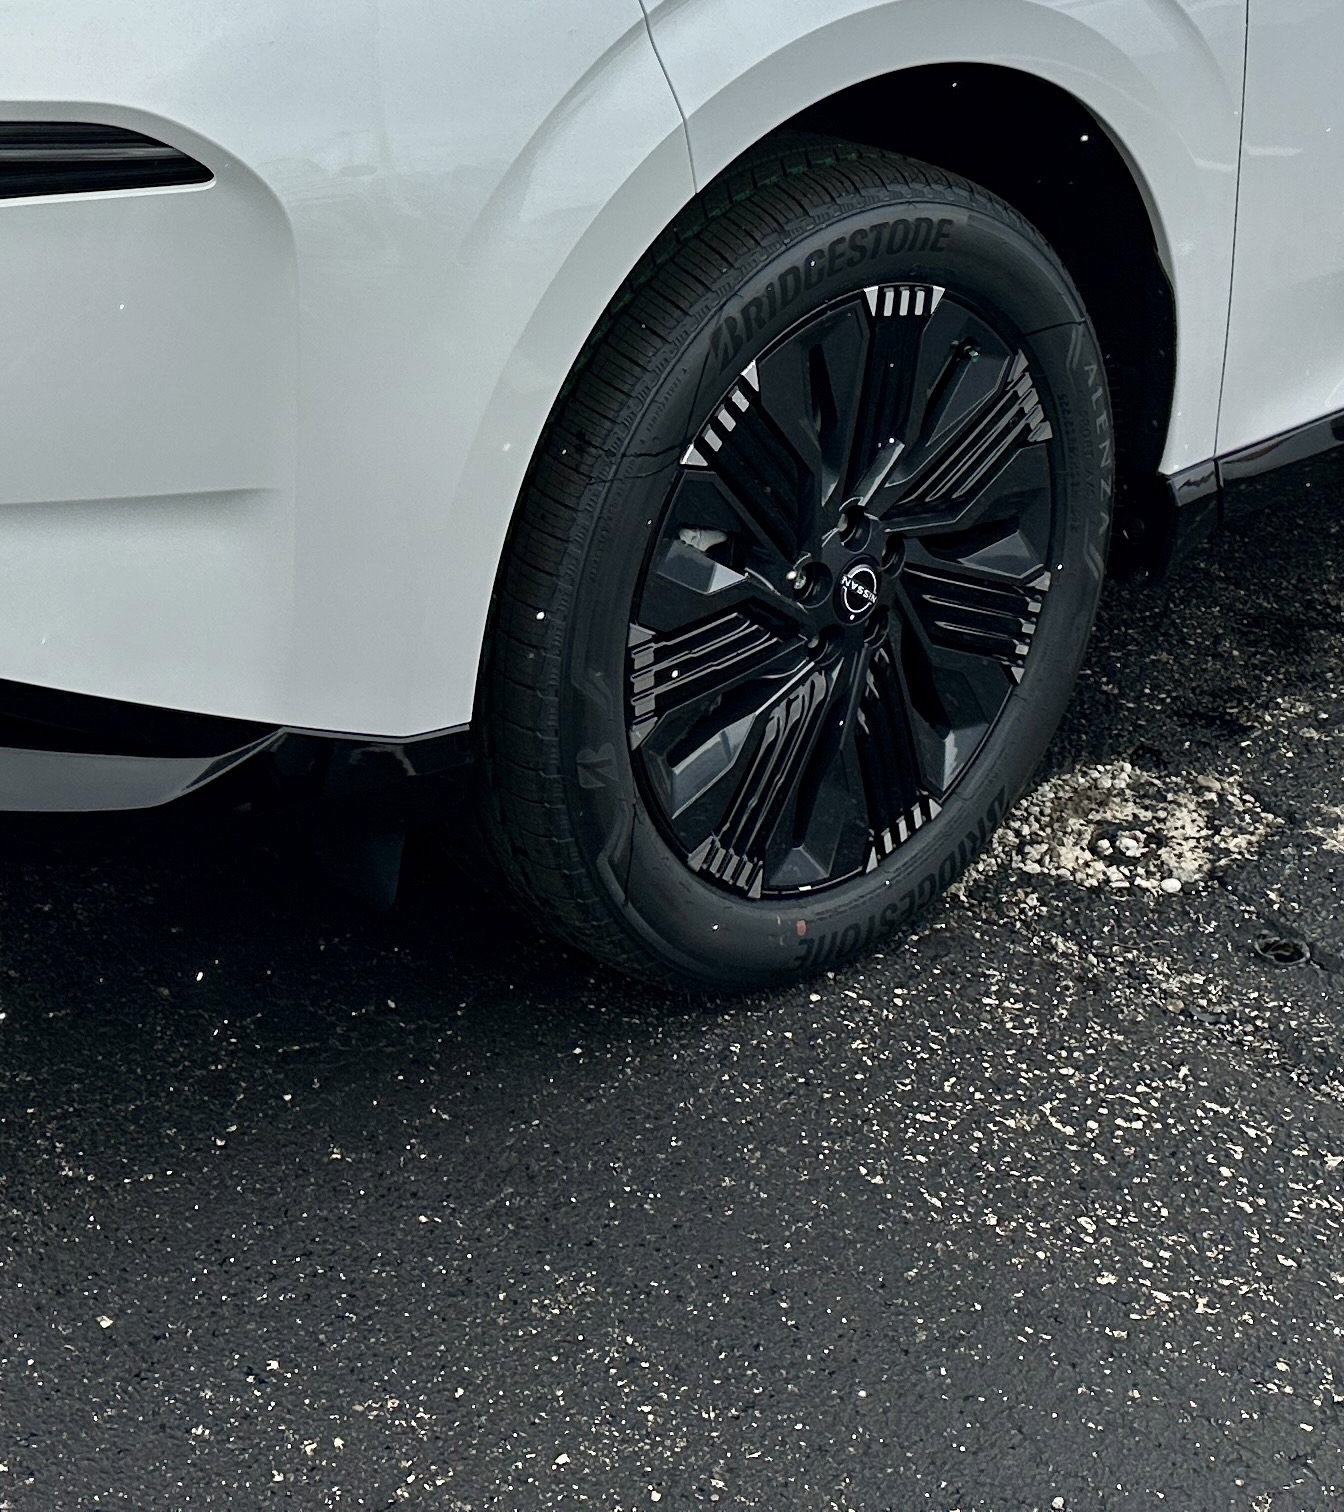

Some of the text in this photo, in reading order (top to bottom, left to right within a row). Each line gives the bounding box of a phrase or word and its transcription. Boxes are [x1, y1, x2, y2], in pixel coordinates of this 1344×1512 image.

[707, 217, 954, 375] BRIDGESTONE
[1083, 363, 1113, 537] ALENZA
[840, 574, 878, 604] NISSAN
